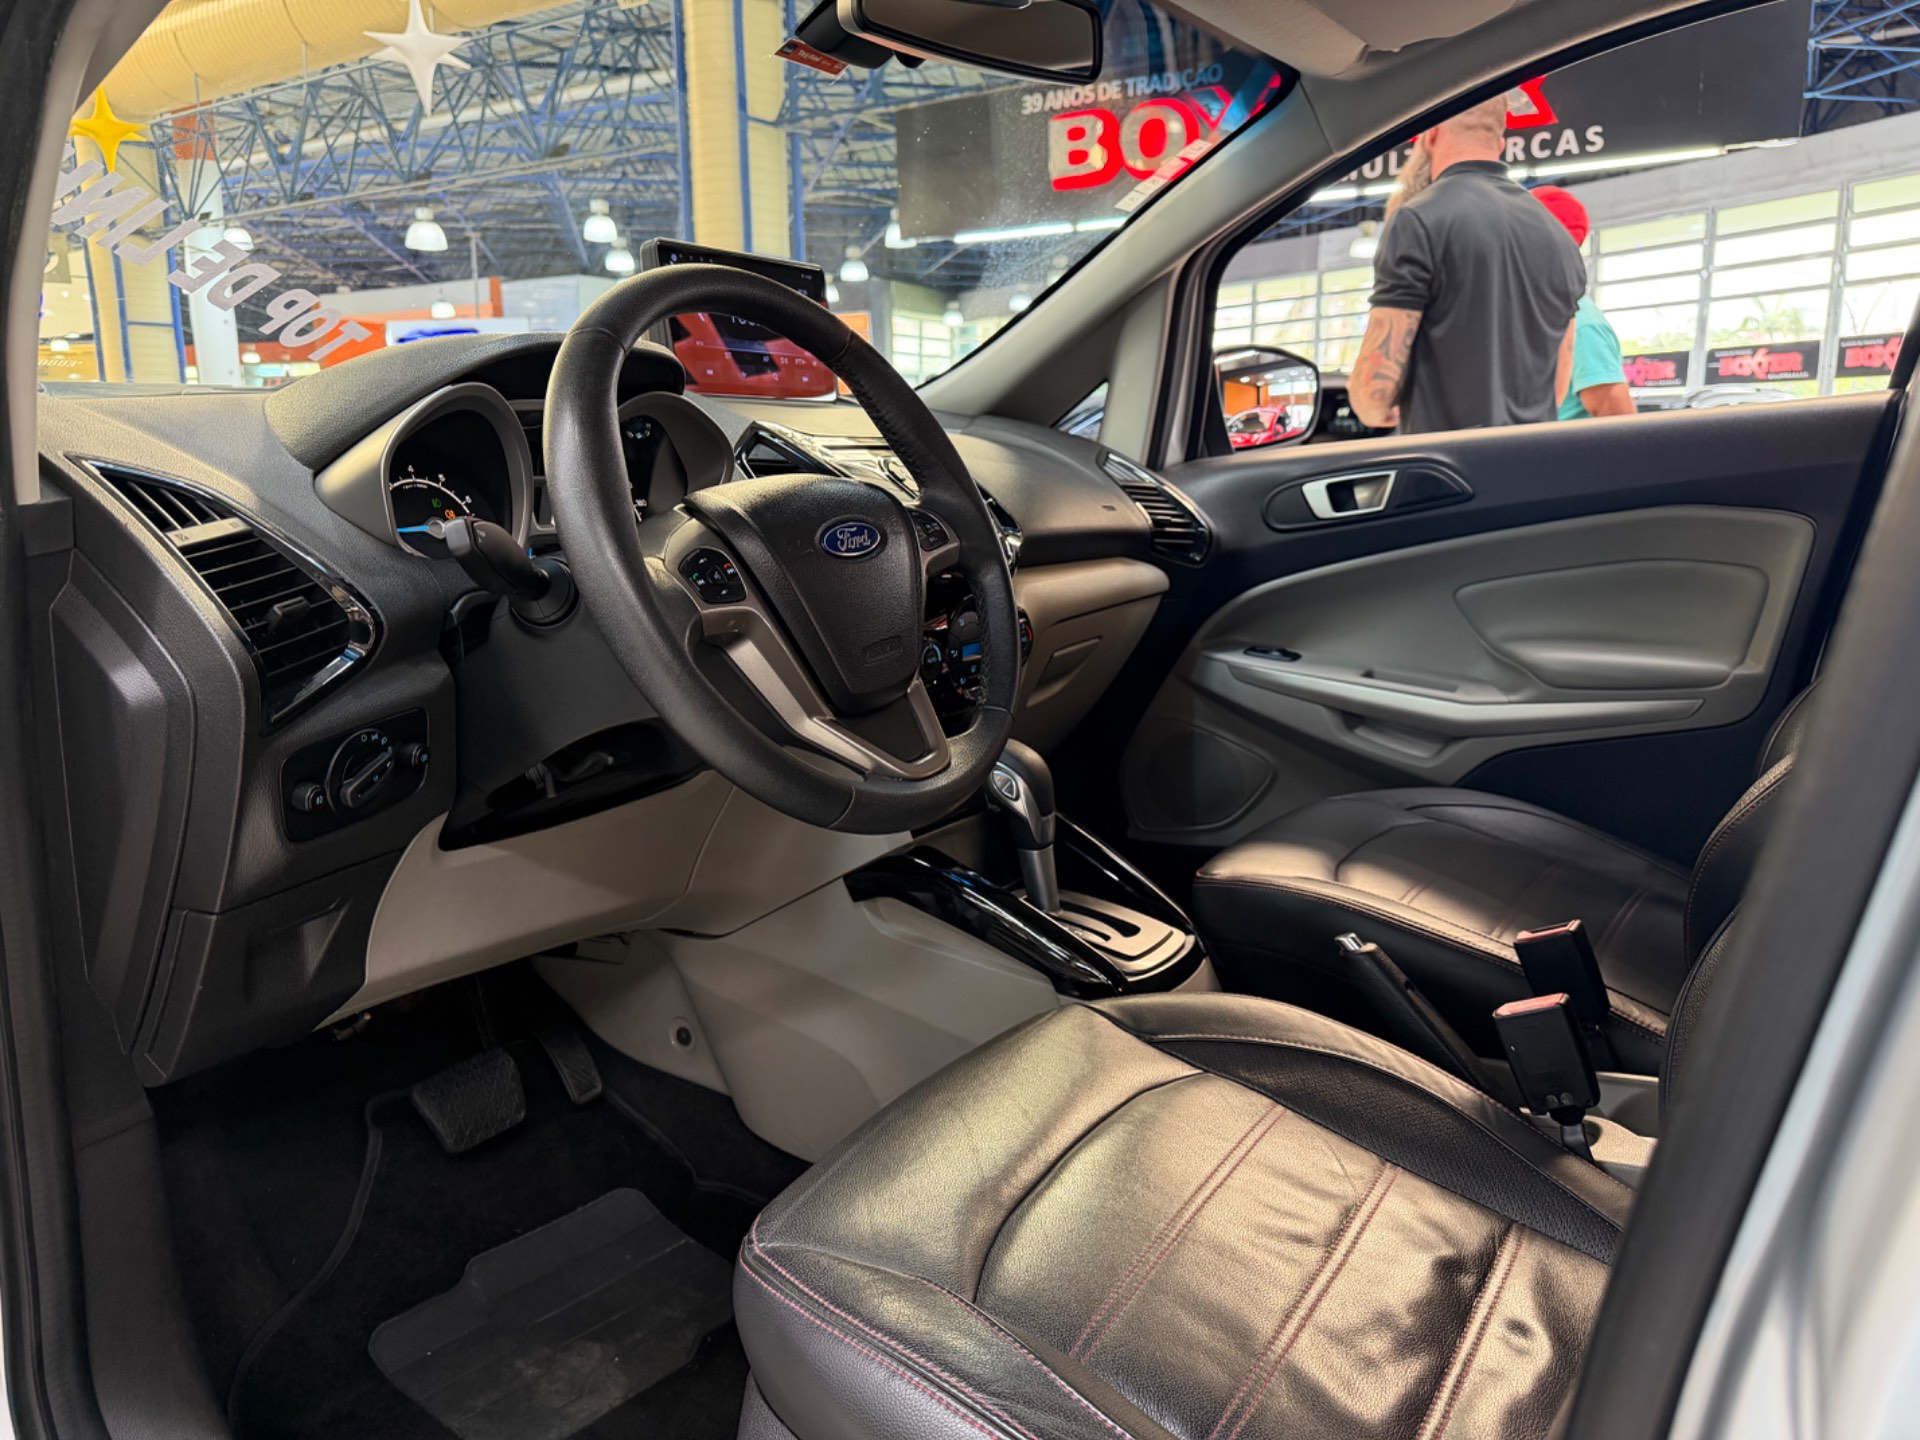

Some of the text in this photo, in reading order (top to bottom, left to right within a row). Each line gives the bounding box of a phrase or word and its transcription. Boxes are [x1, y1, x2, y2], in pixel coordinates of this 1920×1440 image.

[1021, 62, 1223, 115] 39 ANOS DE TRADIÇÃO
[836, 526, 871, 552] Ford
